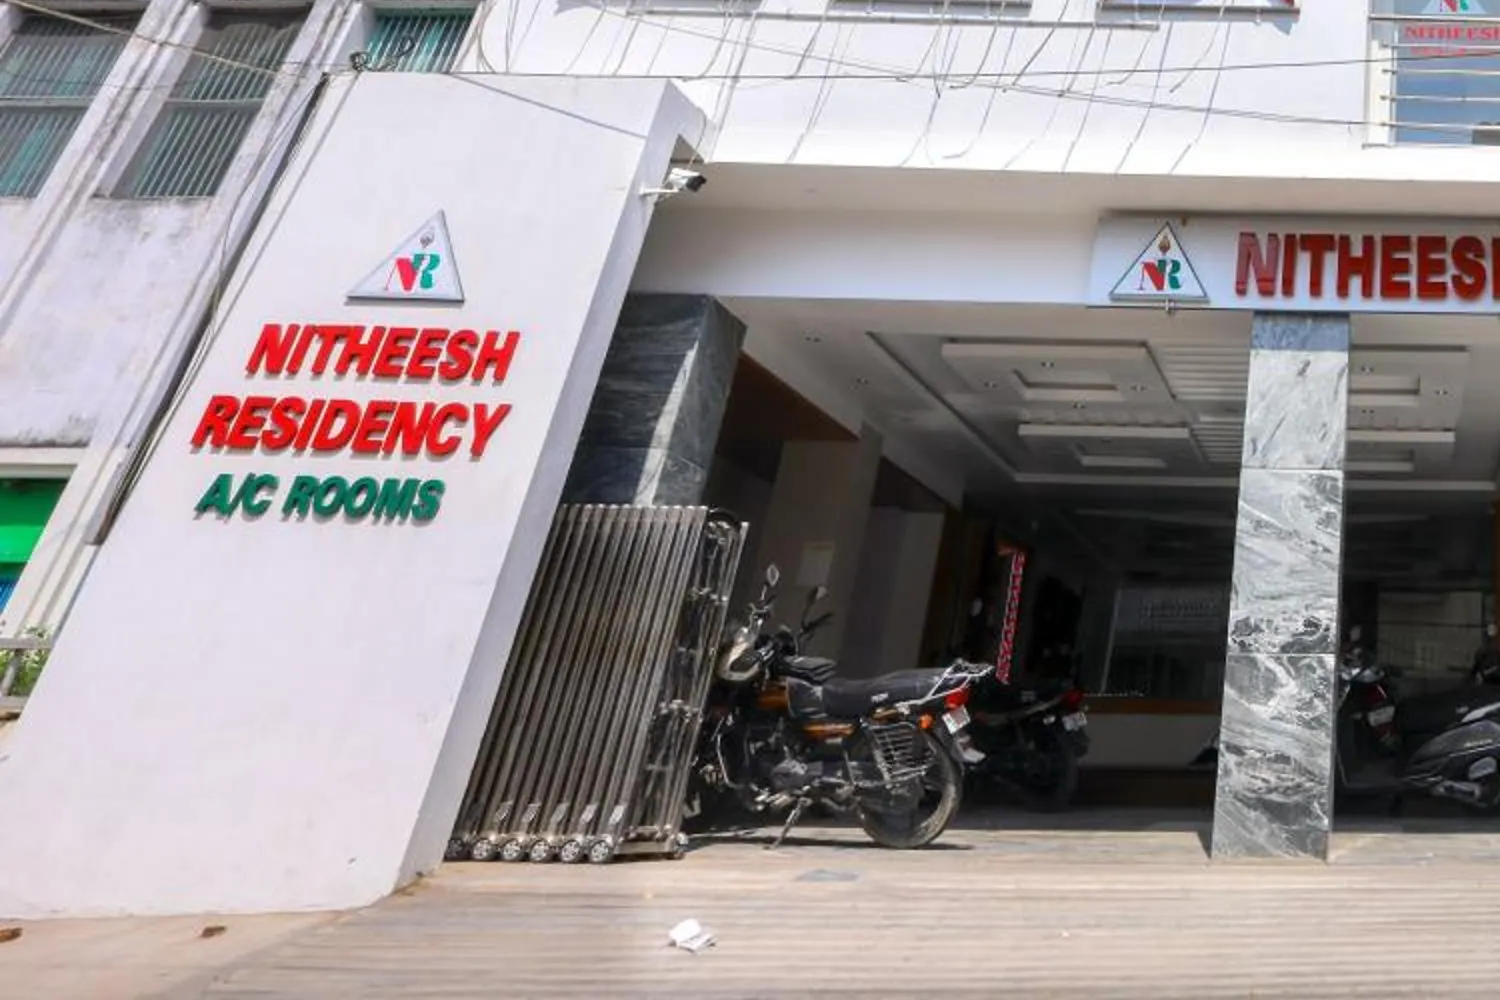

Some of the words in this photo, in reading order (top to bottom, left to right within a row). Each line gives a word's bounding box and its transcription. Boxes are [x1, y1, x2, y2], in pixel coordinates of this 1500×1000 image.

[1137, 258, 1182, 292] NR
[245, 323, 521, 382] NITHEESH
[190, 394, 513, 457] RESIDENCY
[193, 472, 280, 517] A/C
[281, 475, 446, 521] ROOMS
